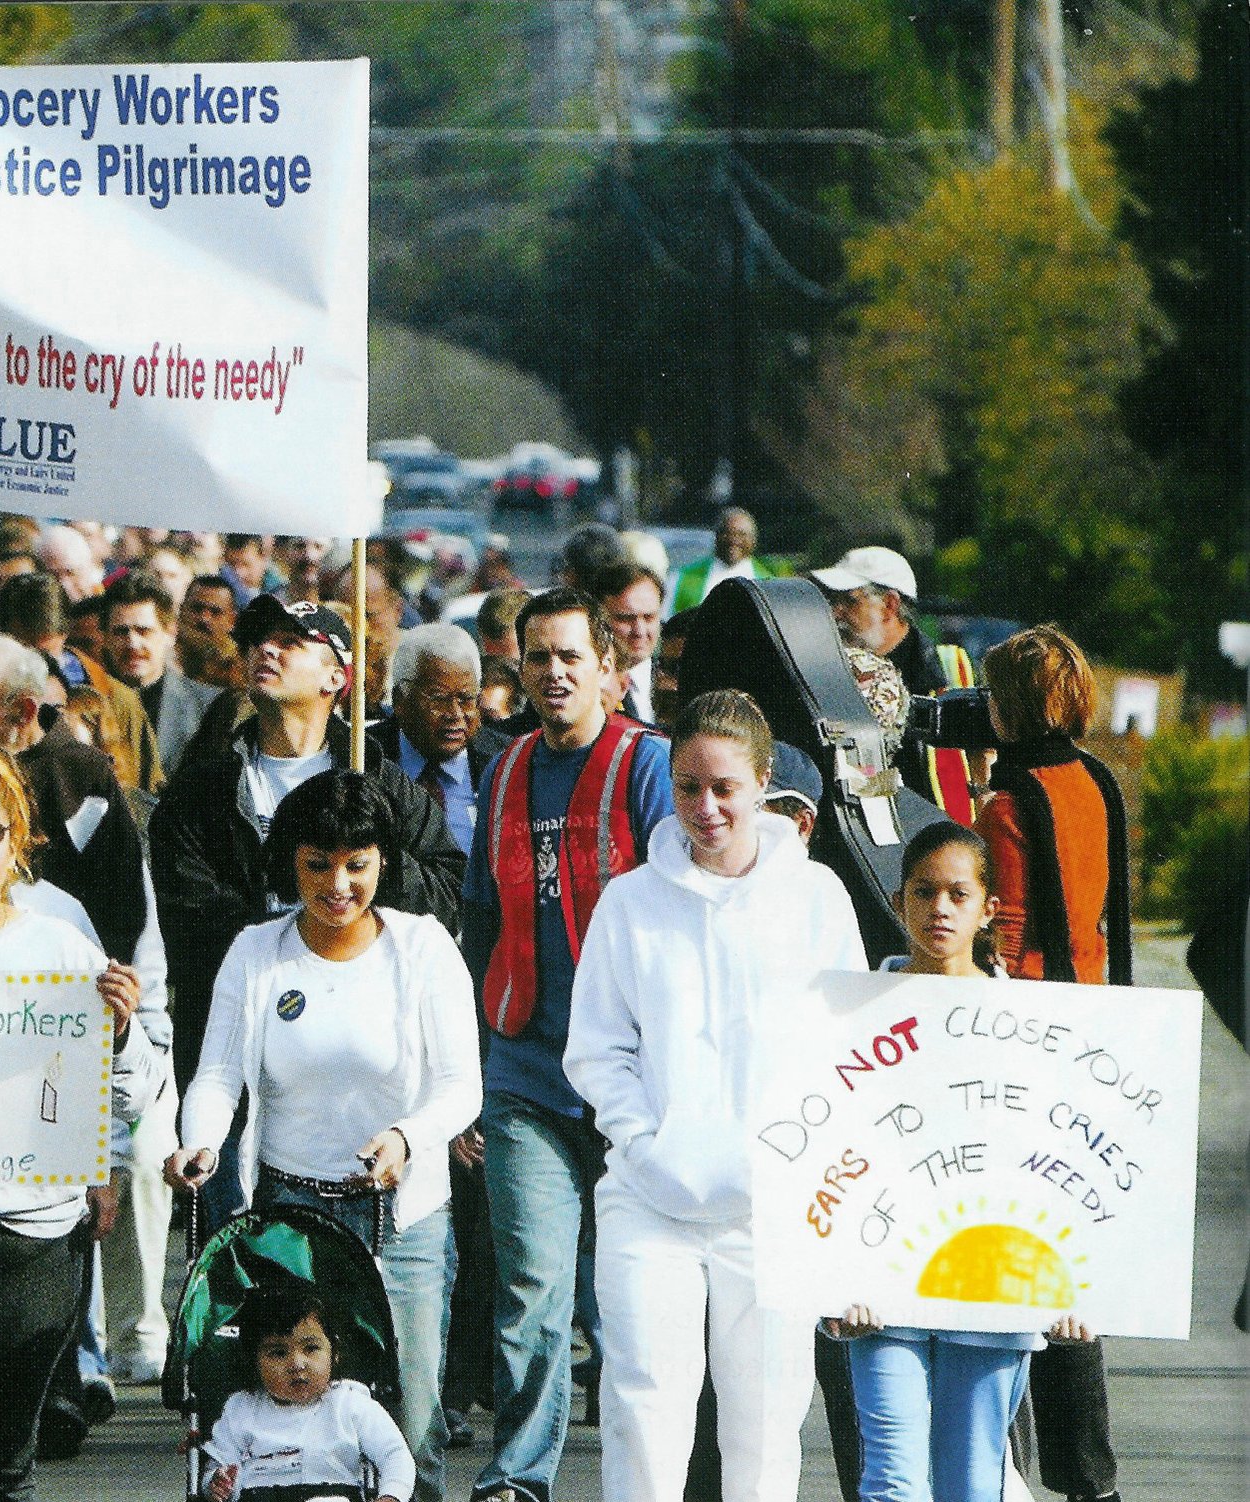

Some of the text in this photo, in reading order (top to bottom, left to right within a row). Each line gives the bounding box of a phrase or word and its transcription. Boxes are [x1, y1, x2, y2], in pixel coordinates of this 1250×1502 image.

[113, 74, 280, 126] Workers
[97, 143, 312, 209] Pilgrimage
[5, 332, 30, 386] to
[37, 334, 76, 391] the
[84, 352, 125, 410] cry
[133, 341, 161, 397] of
[166, 343, 205, 400] the
[213, 345, 305, 416] needy"
[758, 1006, 1163, 1161] DO NOT CLOSE YOUR
[805, 1080, 1144, 1239] EARS TO THE CRIES
[859, 1142, 1116, 1247] OF THE NEEDY
